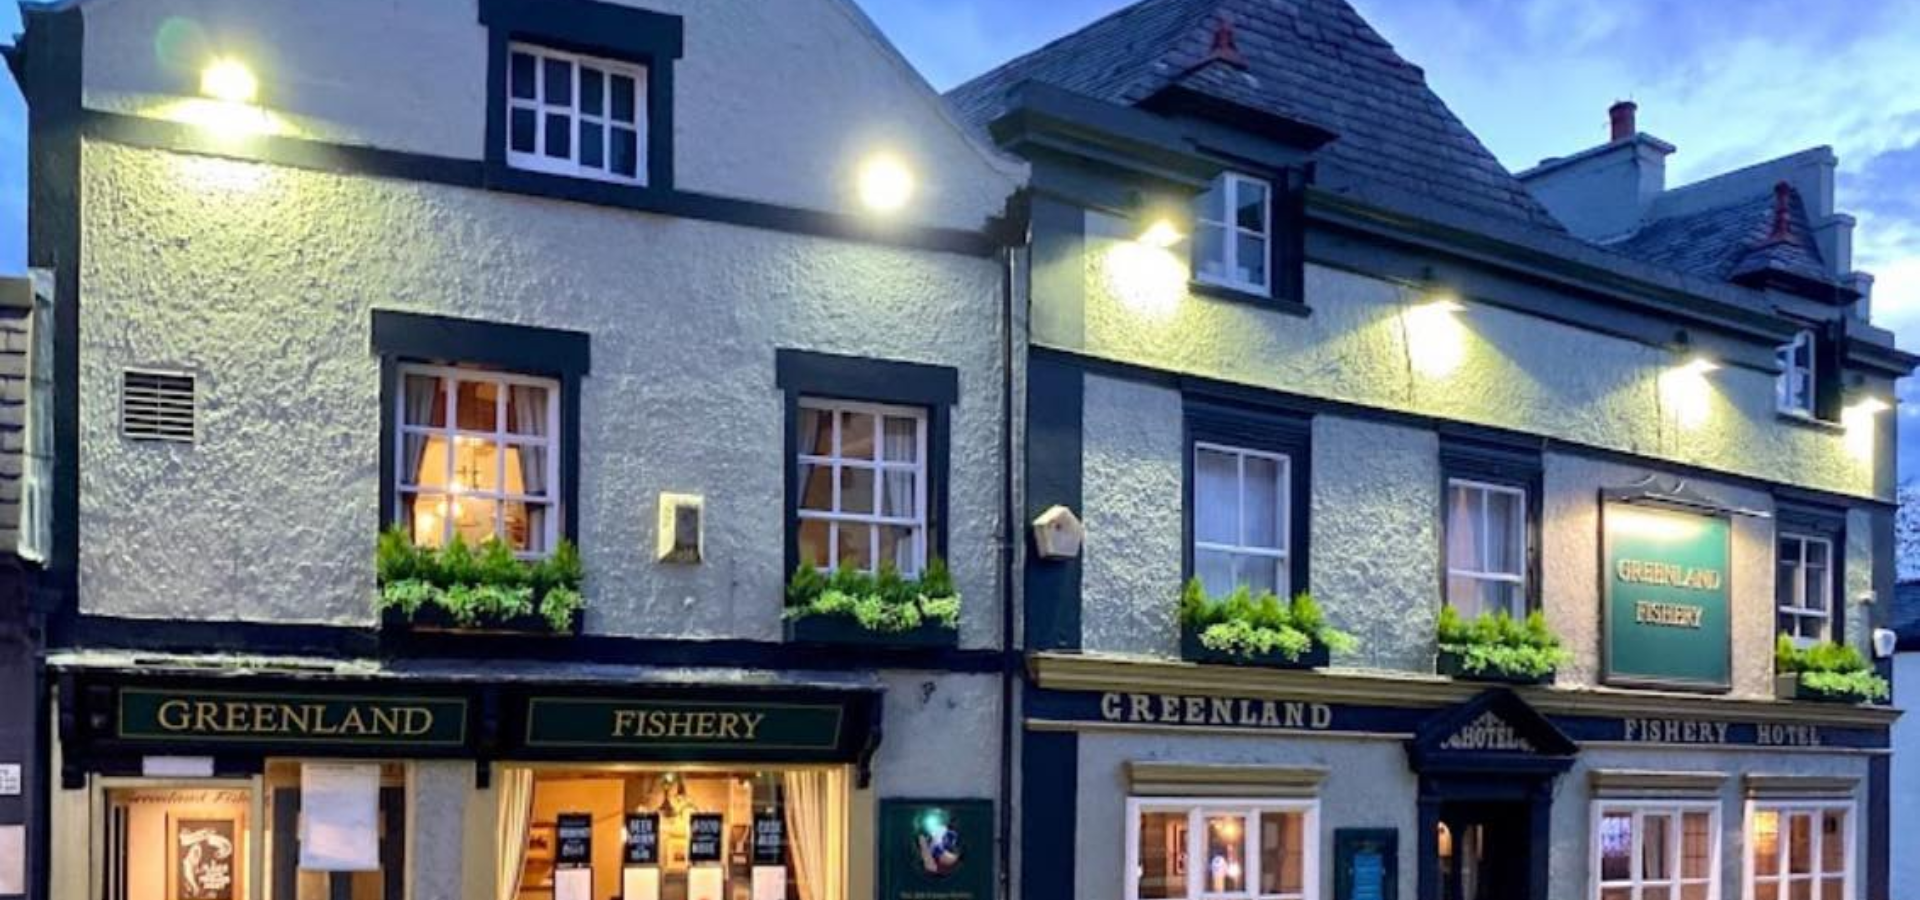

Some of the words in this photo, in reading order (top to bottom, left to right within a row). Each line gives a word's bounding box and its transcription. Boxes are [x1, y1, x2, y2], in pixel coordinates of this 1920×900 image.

[1617, 559, 1721, 590] GREENLAND
[1636, 601, 1703, 628] FISHERY
[157, 701, 434, 735] GREENLAND
[611, 709, 766, 739] FISHERY
[1101, 692, 1333, 729] GREENLAND
[1461, 726, 1519, 750] HOTEL
[1624, 719, 1730, 743] FISHERY
[1756, 725, 1820, 745] HOTEL
